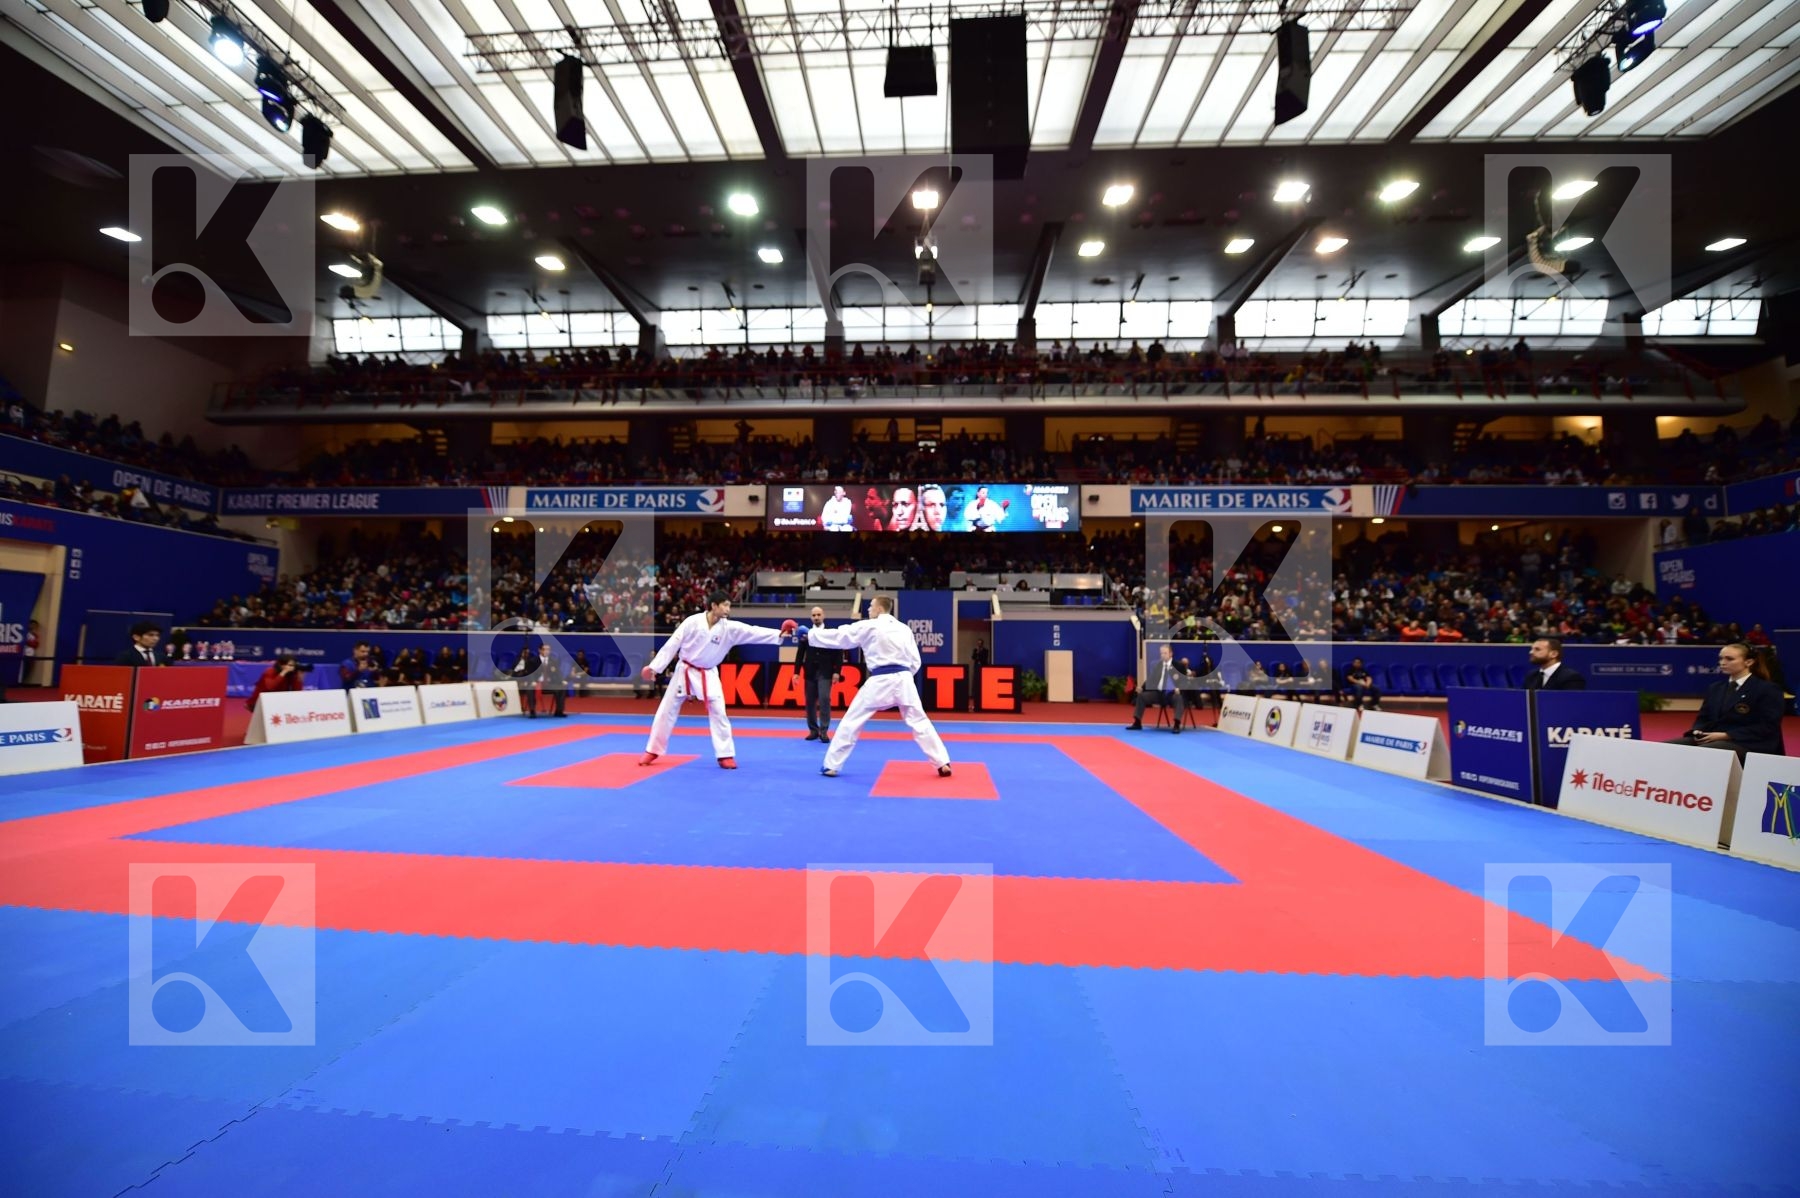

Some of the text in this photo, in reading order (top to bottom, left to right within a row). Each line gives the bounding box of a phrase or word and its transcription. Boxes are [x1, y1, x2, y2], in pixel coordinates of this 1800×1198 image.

[113, 470, 212, 506] OPEN DE PARIS
[227, 493, 380, 509] KARATE PREMIER LEAGUE
[532, 493, 686, 508] MAIRIE DE PARIS
[1139, 493, 1310, 509] MAIRIE DE PARIS
[907, 619, 933, 633] OPEN
[915, 632, 944, 647] PARIS
[720, 664, 1015, 710] KARTE
[9, 732, 46, 743] PARIS
